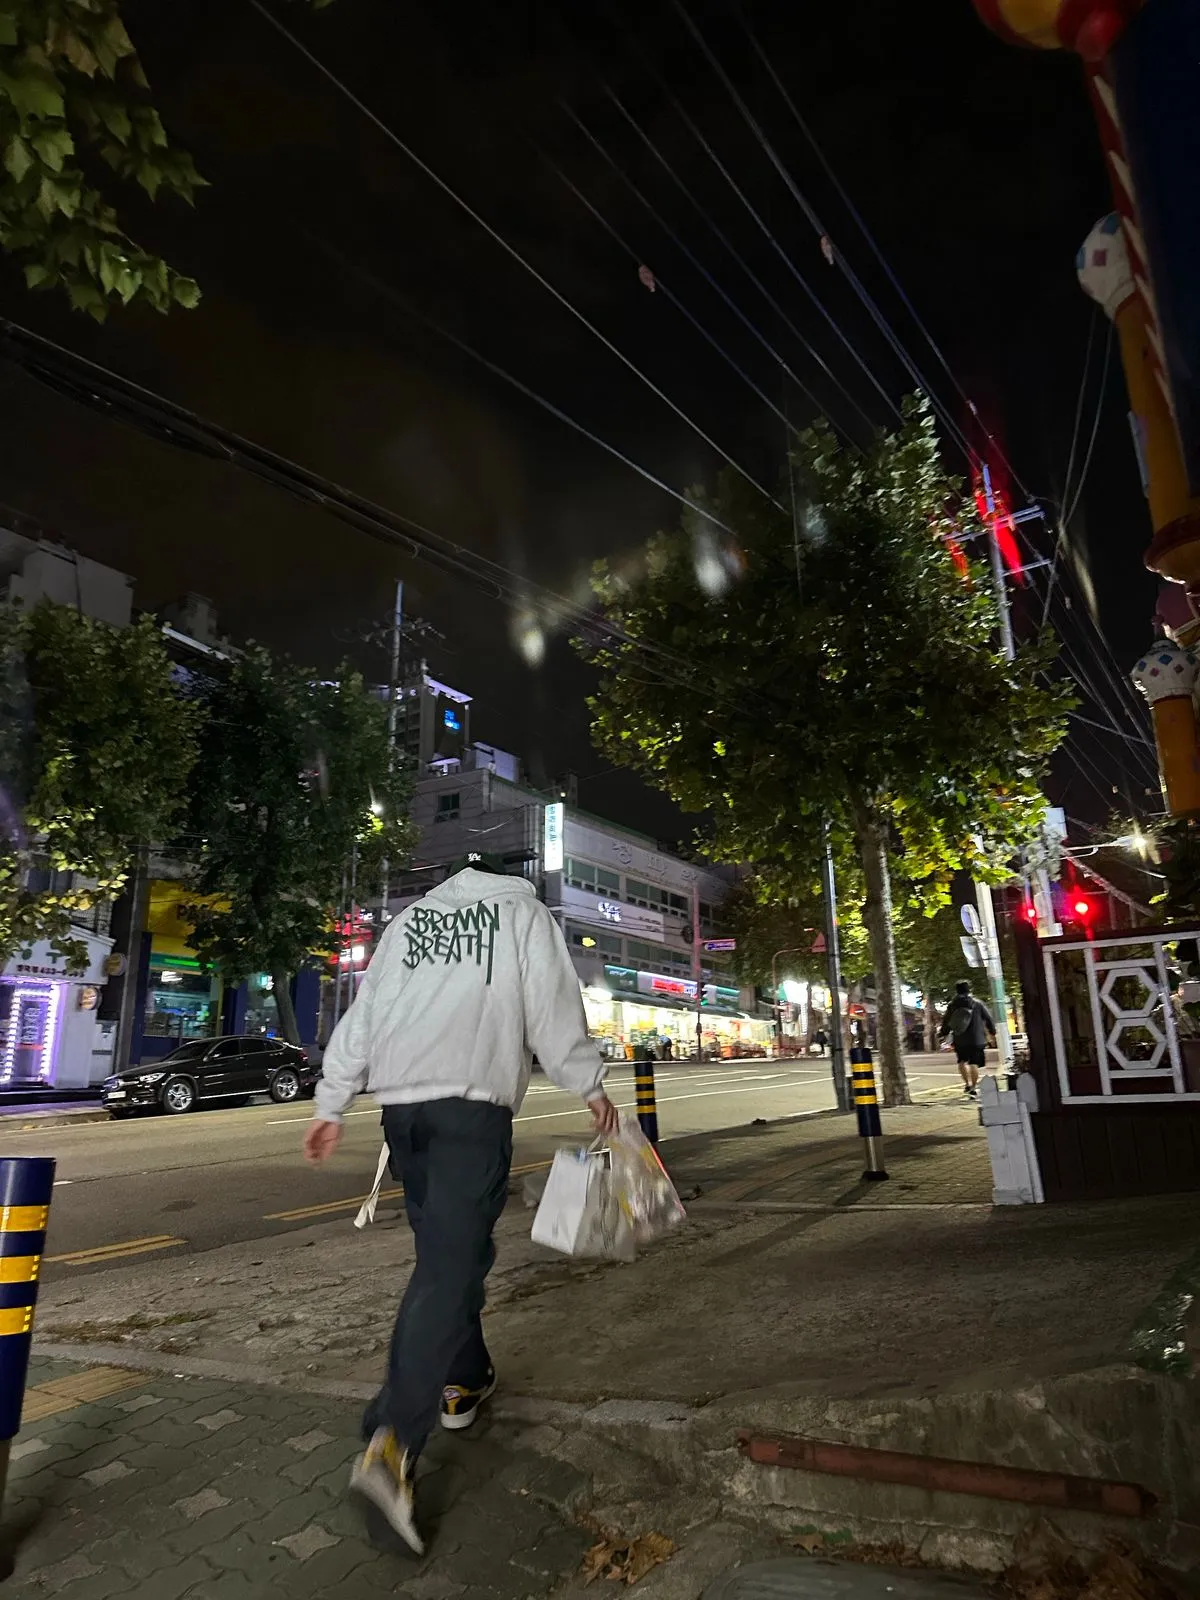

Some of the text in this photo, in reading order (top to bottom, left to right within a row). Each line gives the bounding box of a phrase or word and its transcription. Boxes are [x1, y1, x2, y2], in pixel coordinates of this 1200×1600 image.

[468, 853, 482, 862] LA
[404, 900, 499, 935] BROWN
[402, 921, 494, 985] BREATH
